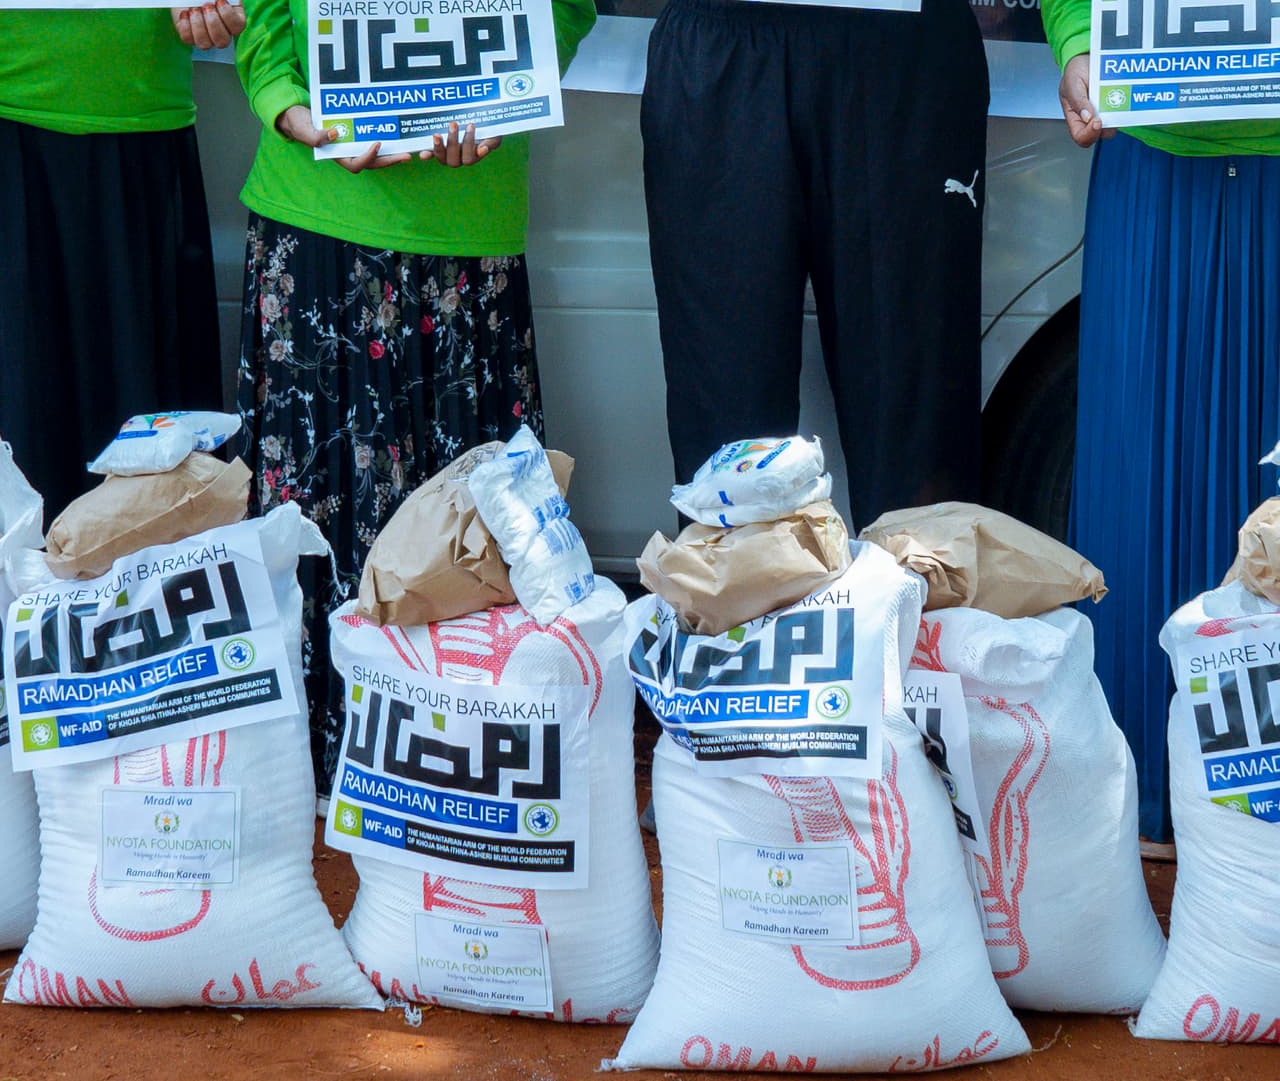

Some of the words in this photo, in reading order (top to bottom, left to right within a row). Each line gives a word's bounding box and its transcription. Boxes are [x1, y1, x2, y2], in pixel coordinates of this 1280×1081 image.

[318, 1, 378, 16] SHARE
[383, 0, 433, 15] YOUR
[1104, 55, 1210, 74] RAMADHAN
[326, 88, 426, 108] RAMADHAN
[432, 82, 493, 100] RELIEF
[1133, 92, 1174, 104] WF-AID
[356, 123, 396, 134] WF-AID
[136, 542, 230, 582] BARAKAH
[1190, 644, 1259, 675] SHARE
[23, 674, 138, 706] RAMADHAN
[140, 652, 208, 687] RELIEF
[106, 712, 120, 721] THE
[120, 702, 168, 719] HUMANITARIAN
[169, 698, 183, 707] ARM
[184, 696, 192, 704] OF
[193, 693, 206, 702] THE
[207, 687, 230, 700] WORLD
[231, 678, 271, 692] FEDERATION
[352, 665, 400, 699] SHARE
[405, 682, 451, 712] YOUR
[456, 698, 556, 720] BARAKAH
[108, 722, 118, 730] OF
[119, 718, 140, 728] KHOJA
[141, 714, 156, 723] SHIA
[202, 697, 226, 708] MUSLIM
[227, 686, 271, 702] COMMUNITIES
[726, 696, 802, 714] RELIEF
[60, 719, 102, 738] WF-AID
[143, 794, 172, 807] Mradi
[175, 796, 193, 807] wa
[344, 770, 437, 813] RAMADHAN
[442, 794, 510, 824] RELIEF
[364, 817, 403, 840] WF-AID
[150, 837, 232, 852] FOUNDATION
[126, 867, 172, 880] Ramadhan
[175, 869, 210, 880] Kareem
[19, 958, 132, 1008] OMAN
[680, 1036, 816, 1072] OMAN
